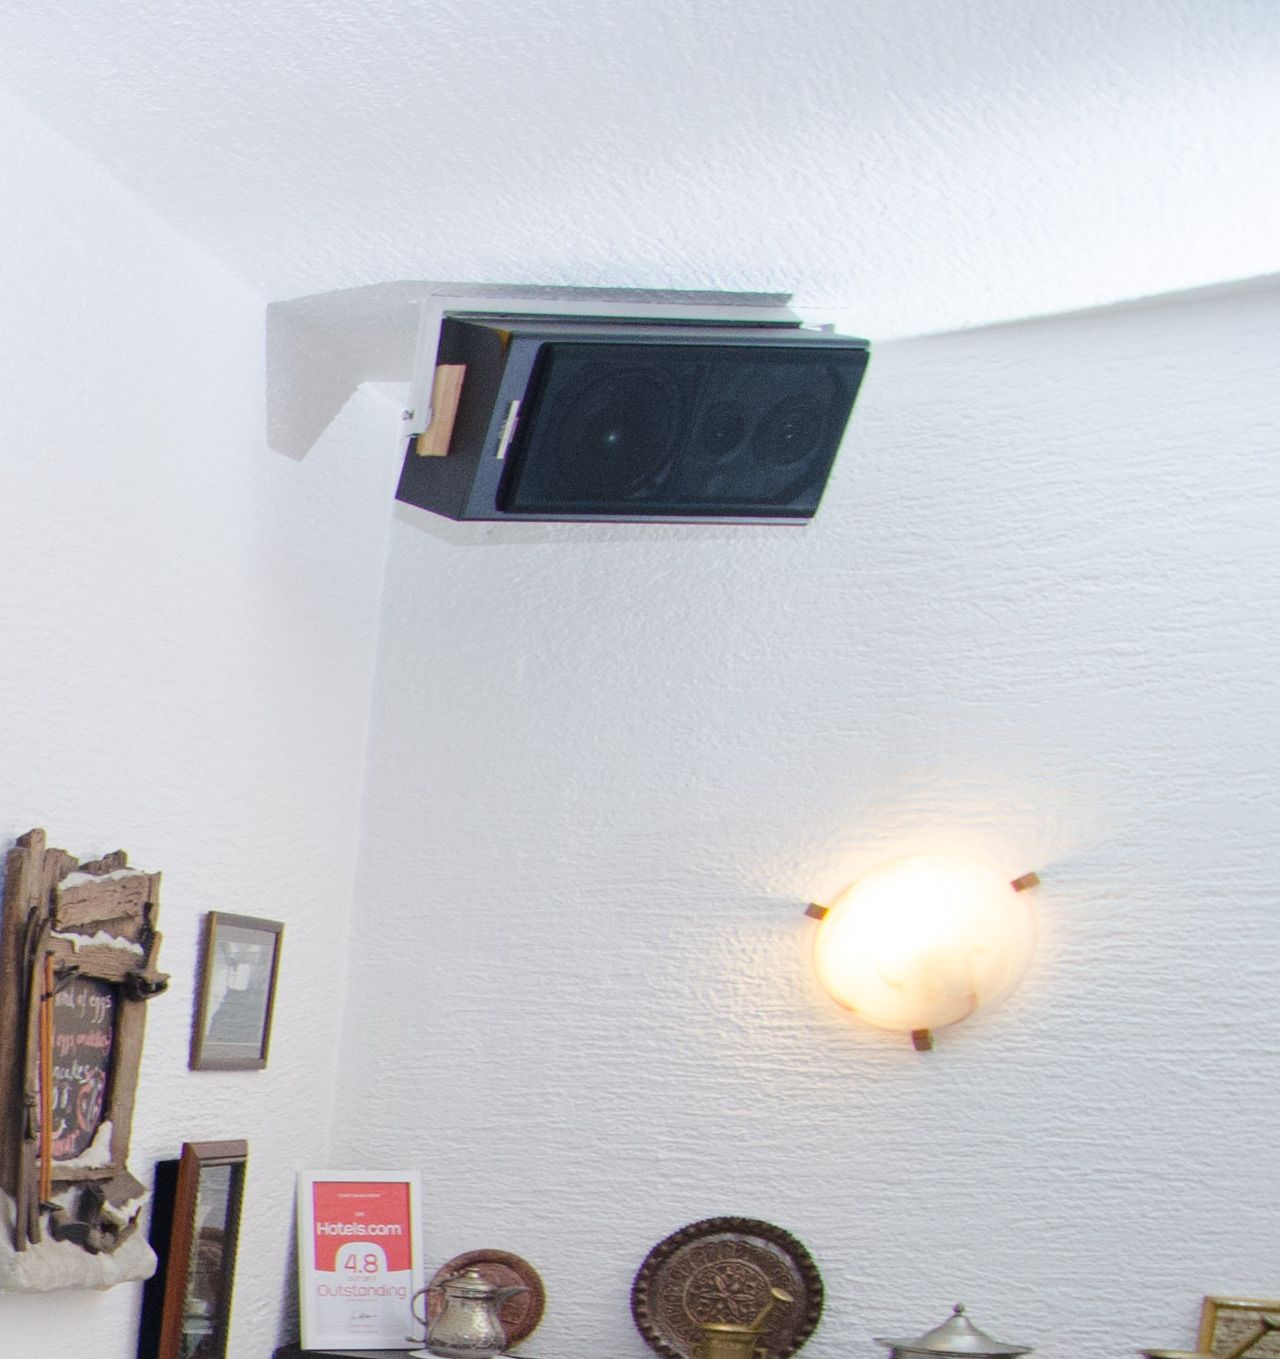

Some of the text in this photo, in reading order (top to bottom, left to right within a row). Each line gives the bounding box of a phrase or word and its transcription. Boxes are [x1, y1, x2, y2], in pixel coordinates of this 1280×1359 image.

[316, 1221, 402, 1236] Hotels.com
[344, 1253, 379, 1274] 4.8
[317, 1284, 407, 1300] Outstanding
